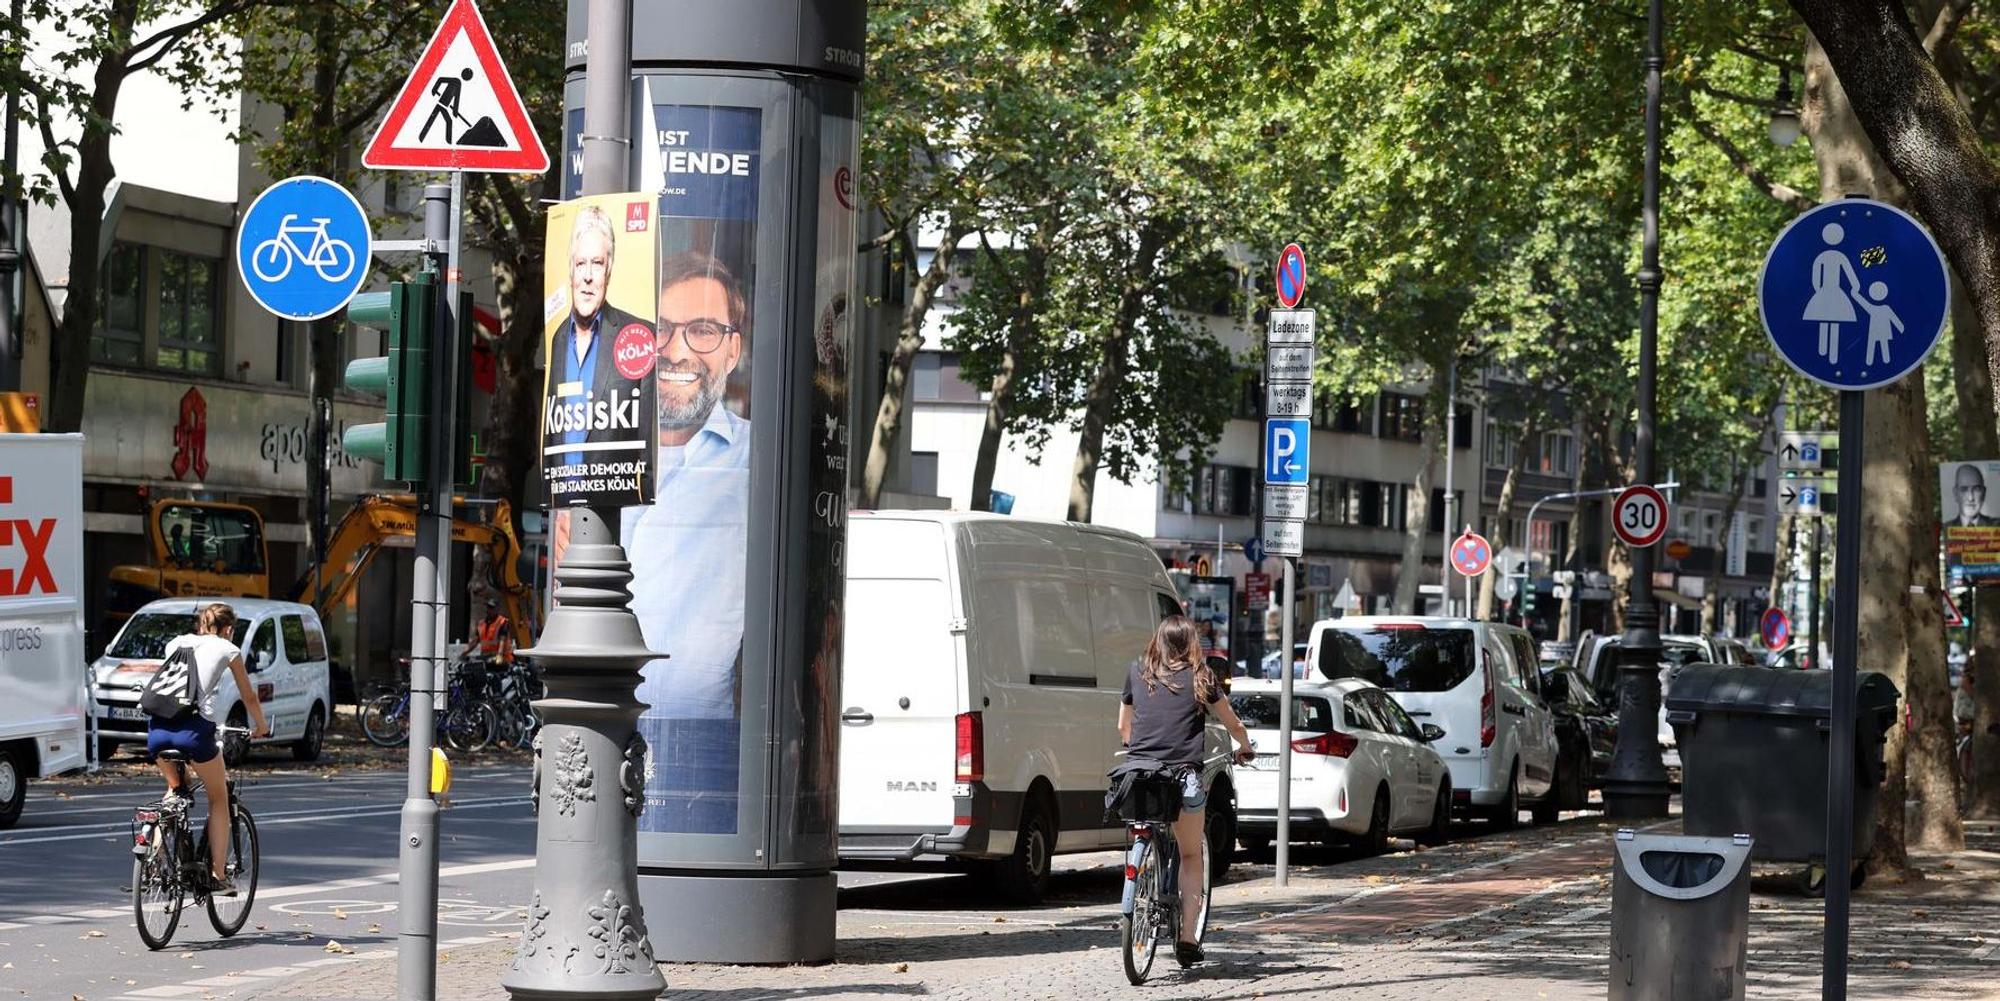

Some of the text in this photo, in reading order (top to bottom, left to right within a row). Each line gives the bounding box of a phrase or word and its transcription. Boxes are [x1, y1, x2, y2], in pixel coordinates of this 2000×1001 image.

[627, 220, 646, 231] SPD
[1273, 320, 1310, 333] Ladezone
[617, 340, 655, 362] KÖLN
[1273, 386, 1307, 400] werktags
[545, 387, 641, 435] Kossiski
[1276, 402, 1300, 413] 8-19 h
[1273, 427, 1297, 475] P
[590, 461, 647, 476] DEMOKRAT
[567, 479, 606, 492] STARKES
[607, 476, 638, 491] KÖLN.
[1624, 503, 1656, 529] 30
[887, 781, 937, 792] MAN
